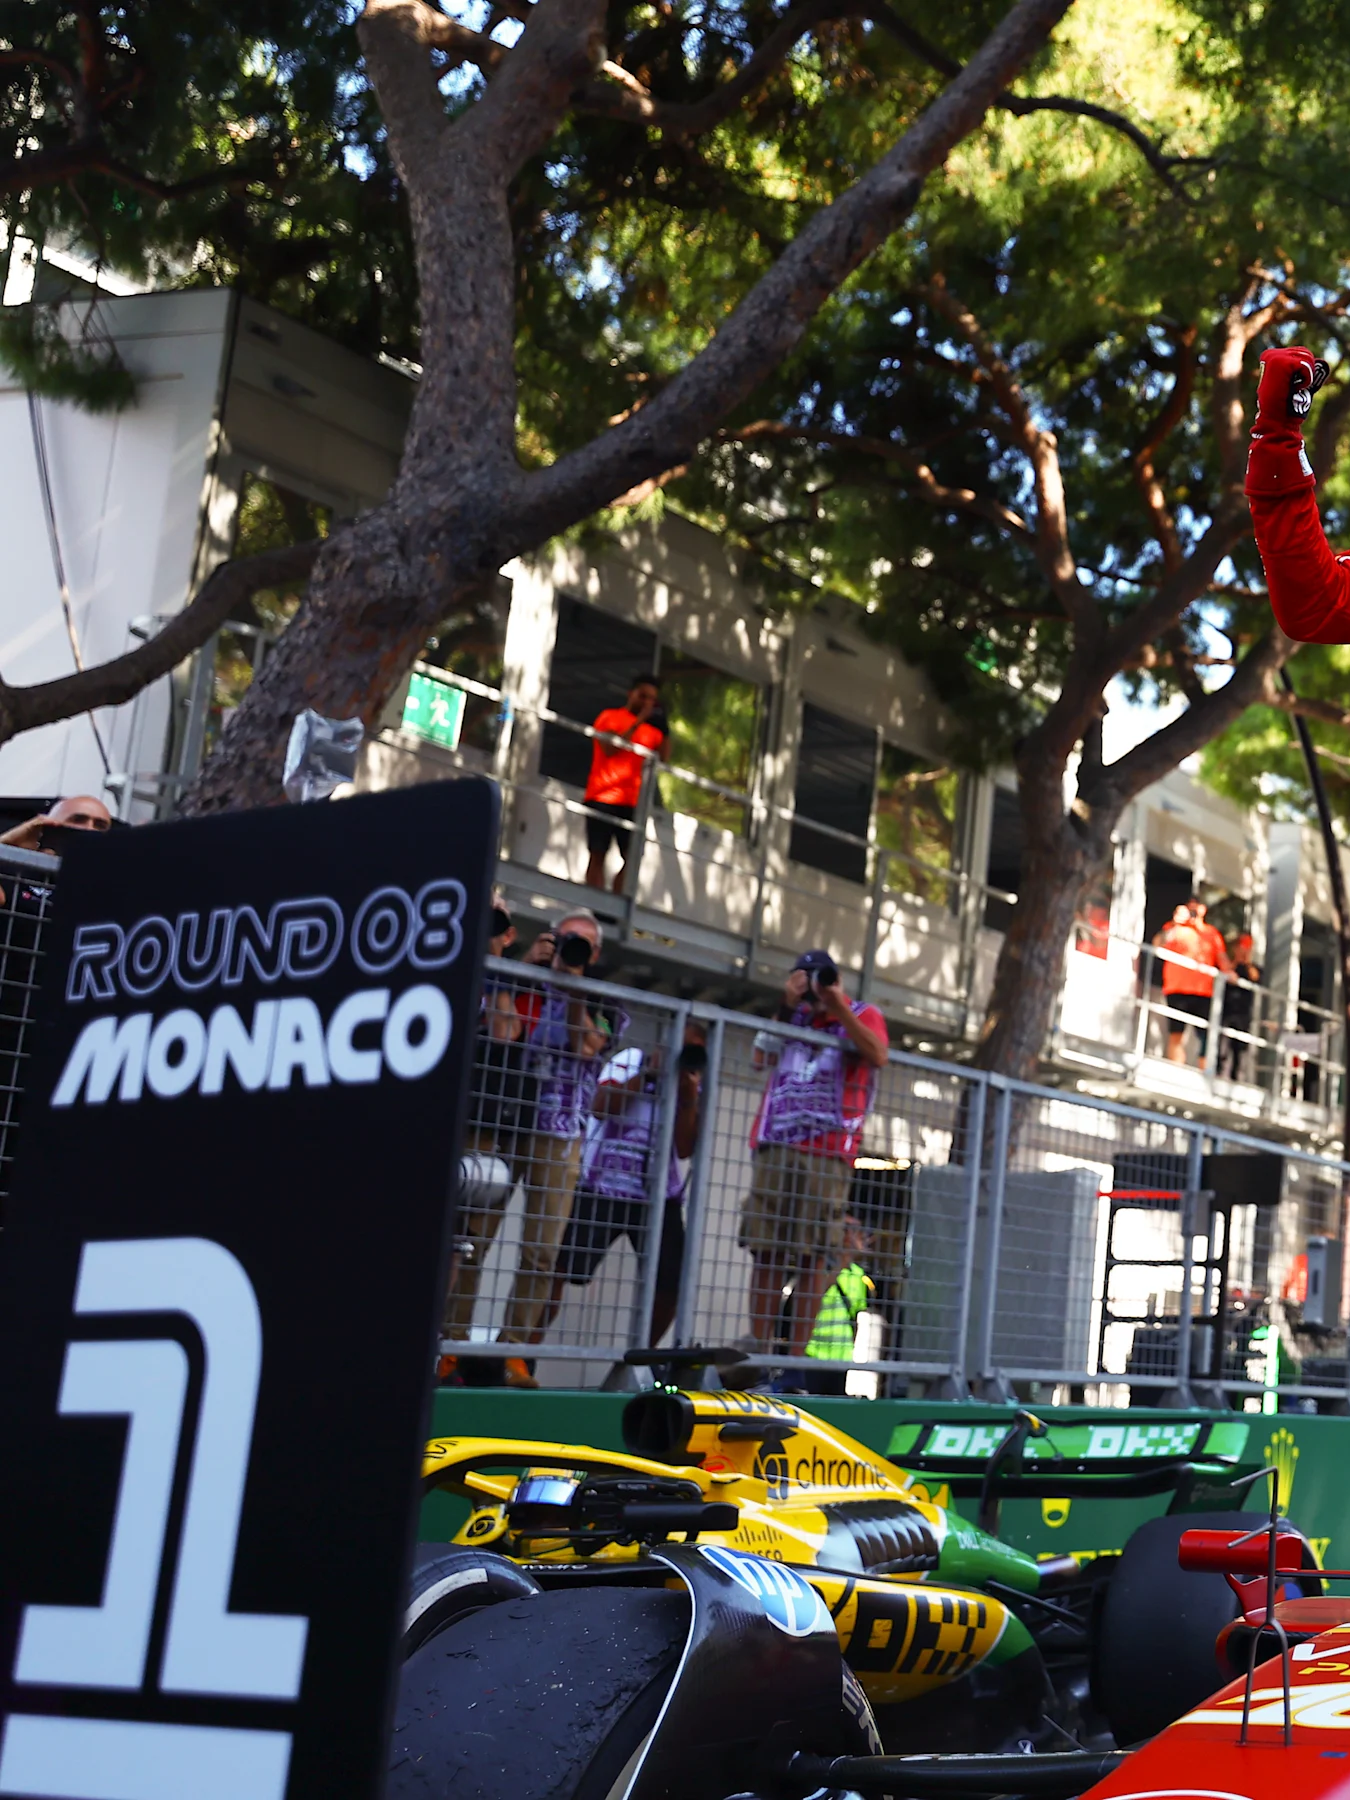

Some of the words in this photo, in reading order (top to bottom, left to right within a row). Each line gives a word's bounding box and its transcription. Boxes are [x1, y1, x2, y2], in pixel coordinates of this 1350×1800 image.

[65, 897, 345, 1001] ROUND
[350, 878, 467, 974] 08
[49, 982, 453, 1108] MONACO
[796, 1446, 889, 1491] chrome
[697, 1544, 821, 1638] hp
